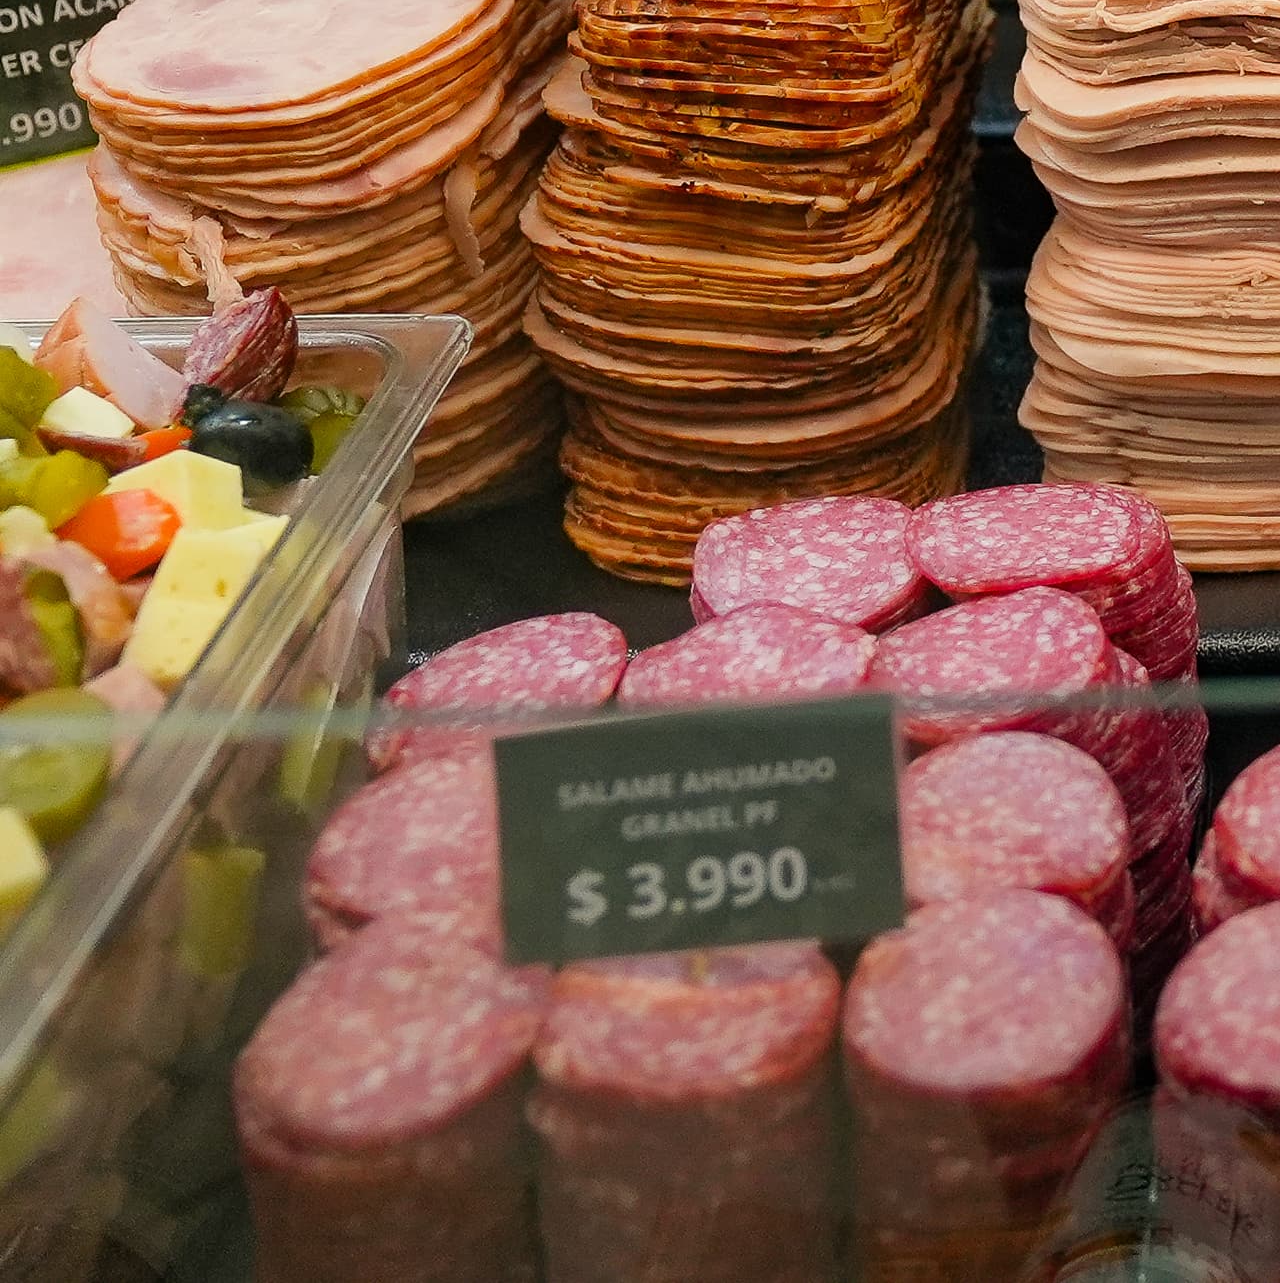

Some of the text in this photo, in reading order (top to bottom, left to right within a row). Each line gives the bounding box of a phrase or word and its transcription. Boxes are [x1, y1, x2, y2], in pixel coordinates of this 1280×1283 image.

[556, 756, 837, 811] SALAME AHUMADO
[564, 845, 809, 926] $ 3.990
